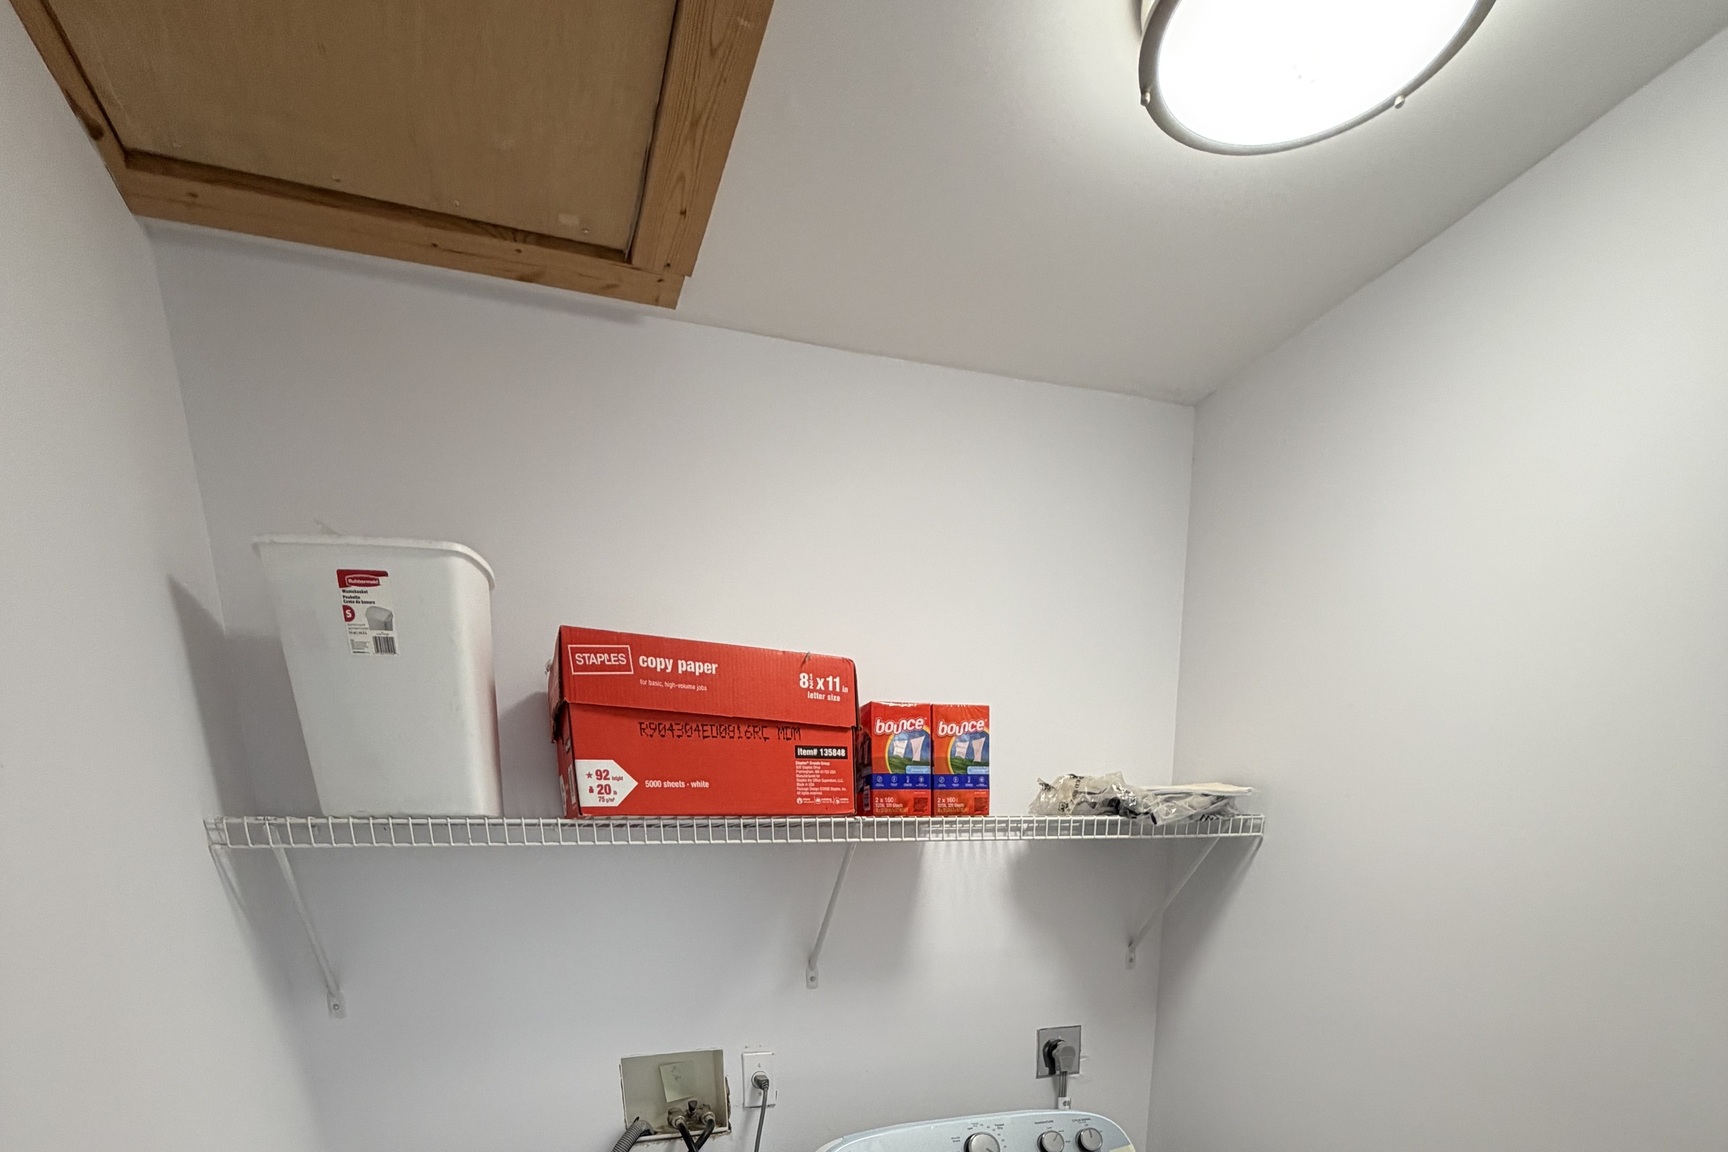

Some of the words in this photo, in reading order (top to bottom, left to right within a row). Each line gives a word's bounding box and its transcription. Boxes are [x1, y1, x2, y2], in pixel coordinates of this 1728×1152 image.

[345, 609, 352, 618] S
[575, 653, 627, 665] STAPLES
[639, 655, 673, 672] copy
[678, 659, 718, 676] paper
[648, 679, 663, 688] basic,
[664, 682, 696, 690] high-volume
[816, 678, 825, 690] x
[827, 676, 841, 692] 11
[807, 691, 826, 700] letter
[827, 692, 841, 702] size
[875, 717, 925, 735] bounce
[938, 719, 985, 737] bounce
[797, 747, 818, 756] Item#
[819, 748, 846, 757] 135848
[594, 769, 611, 781] 92
[596, 784, 612, 795] 20
[644, 780, 662, 788] 5000
[663, 780, 685, 788] sheets
[690, 780, 710, 788] white
